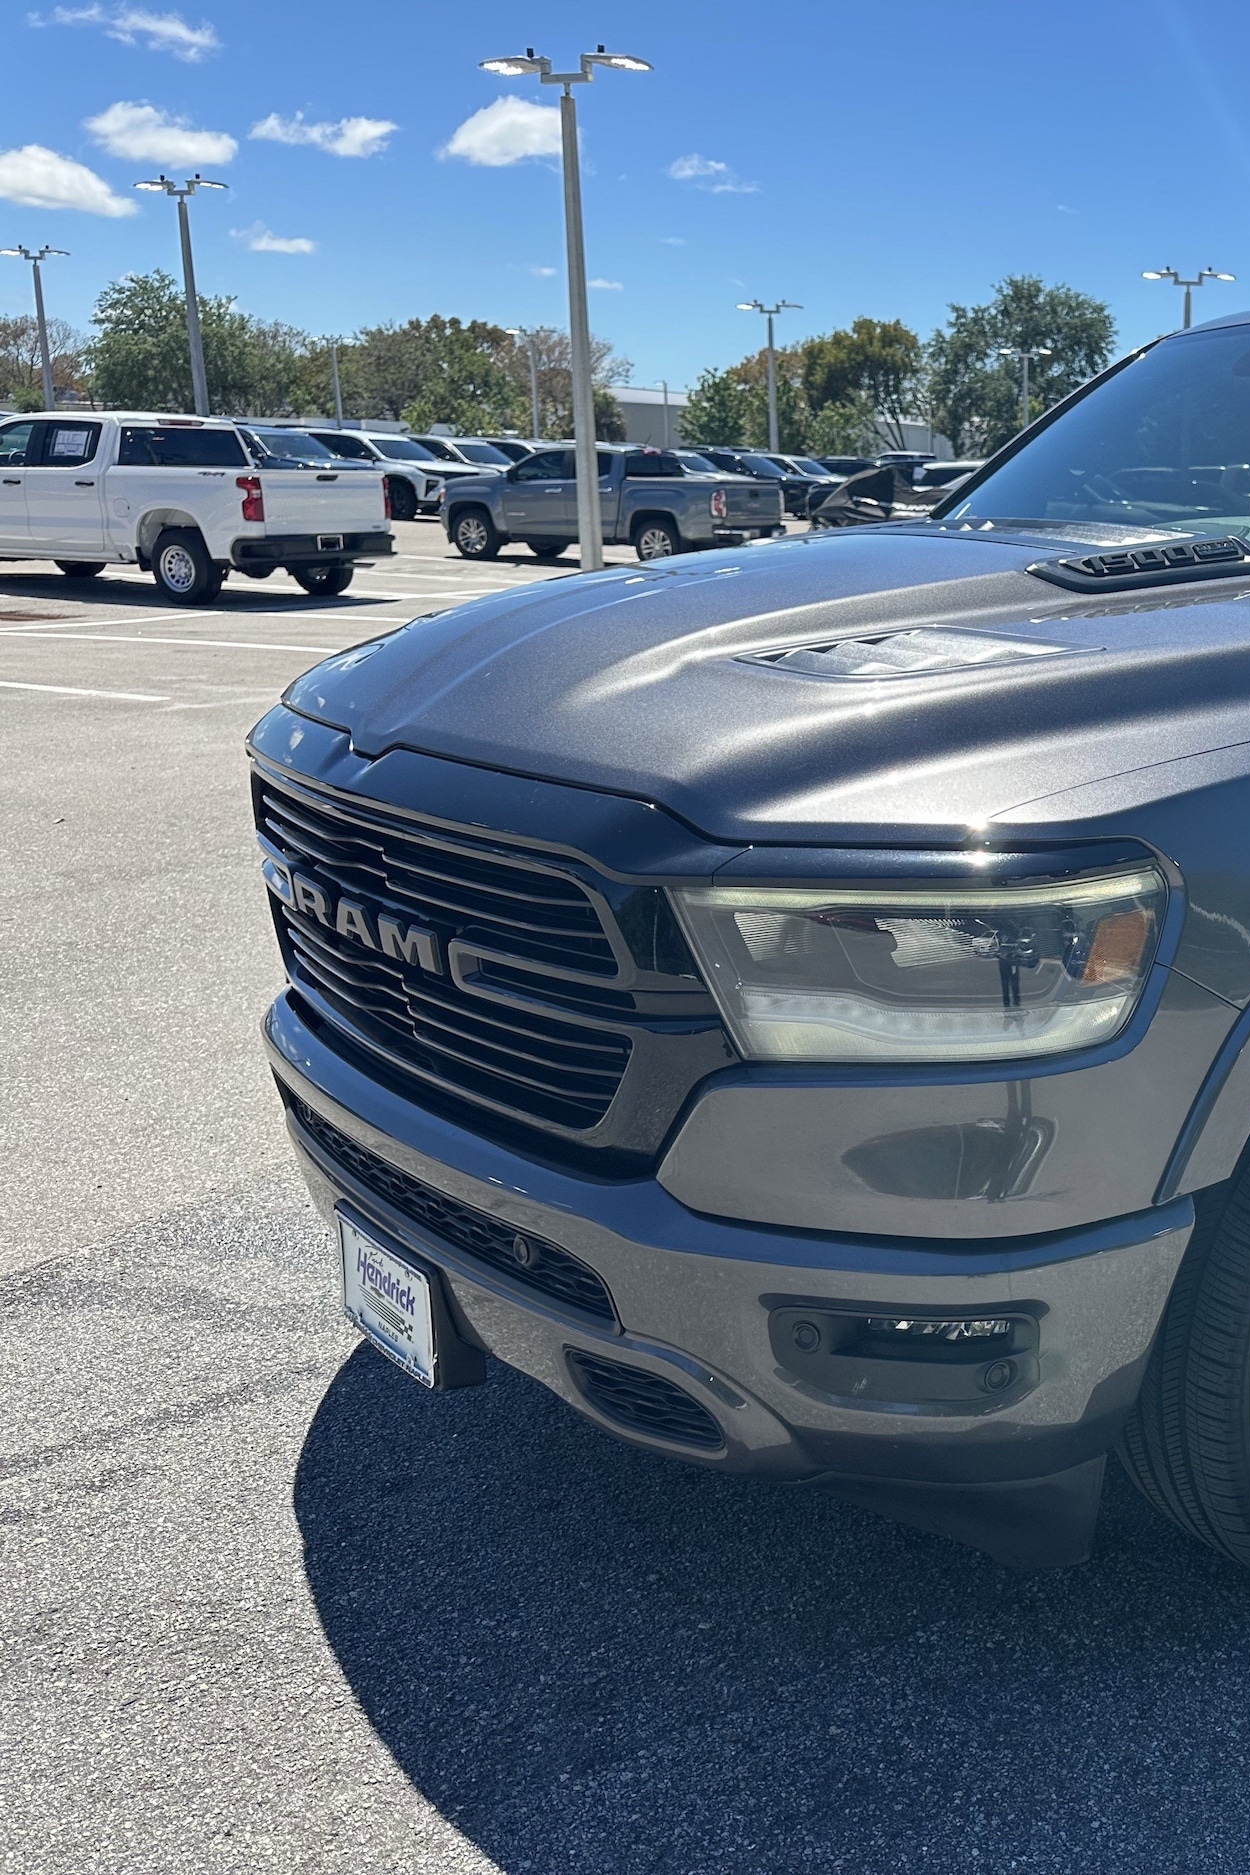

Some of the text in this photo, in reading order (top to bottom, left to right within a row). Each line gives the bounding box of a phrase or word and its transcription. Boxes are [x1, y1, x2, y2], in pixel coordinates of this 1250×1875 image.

[1082, 546, 1196, 577] 1500
[294, 872, 443, 976] RAM
[357, 1247, 416, 1316] Hendrick
[378, 1320, 399, 1343] NAPLES
